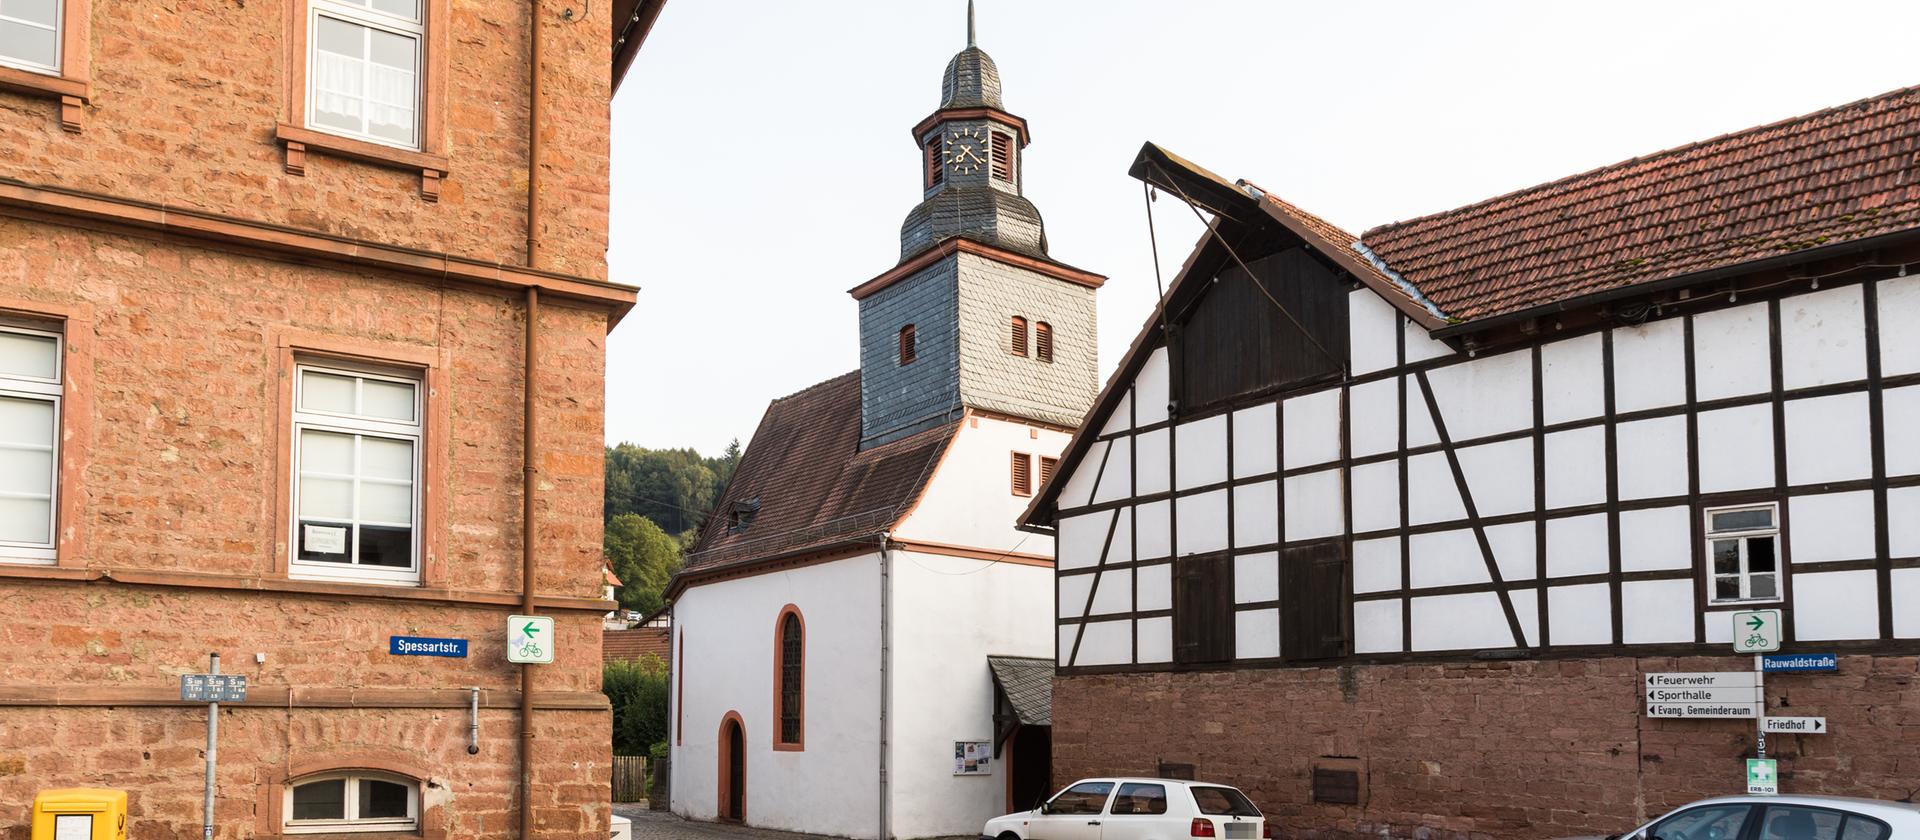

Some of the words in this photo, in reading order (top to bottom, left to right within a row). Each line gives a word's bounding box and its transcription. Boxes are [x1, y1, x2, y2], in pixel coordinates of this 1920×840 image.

[398, 639, 460, 655] Spessartstr.
[1764, 656, 1834, 668] Rauwaldstraße
[1656, 675, 1715, 685] Feuerwehr
[1657, 690, 1712, 701] Sporthalle
[1658, 705, 1685, 716] Evang.
[1687, 705, 1751, 715] Gemeinderaum
[1767, 719, 1806, 729] Friedhof
